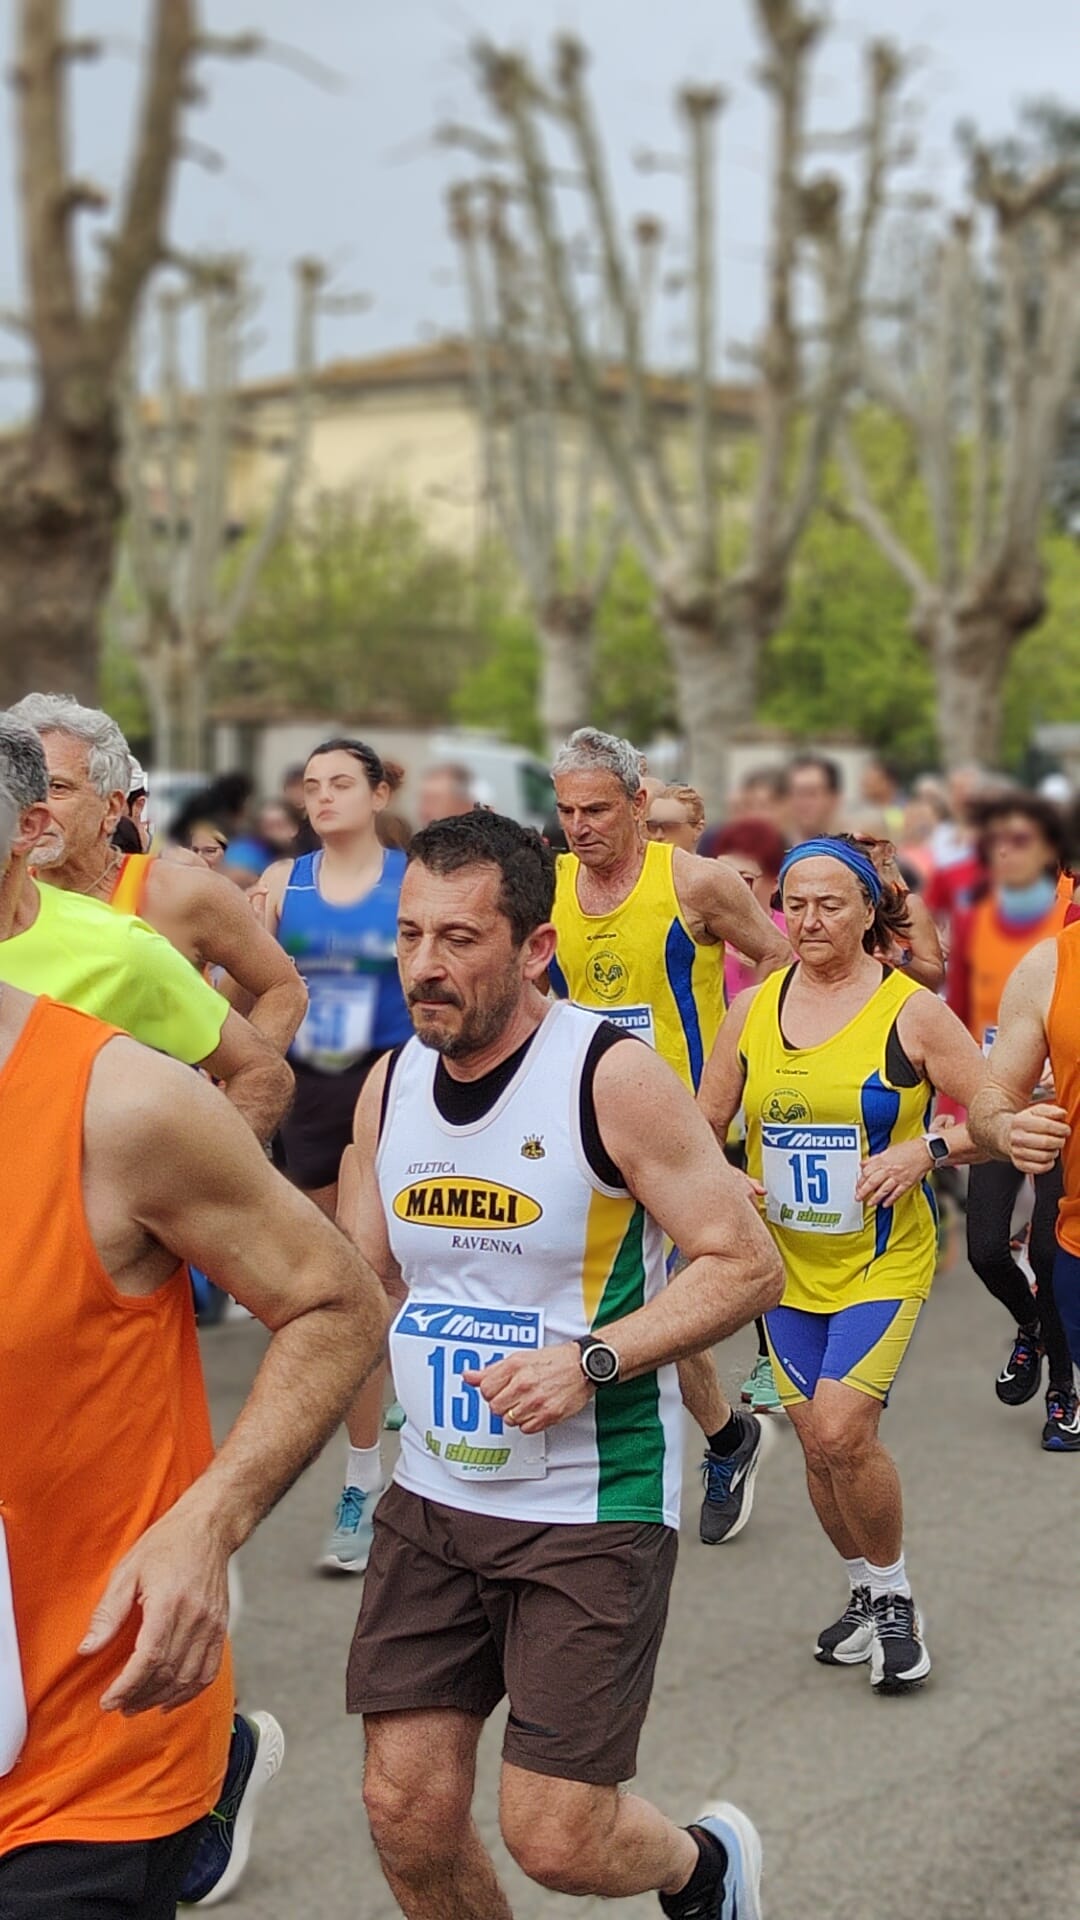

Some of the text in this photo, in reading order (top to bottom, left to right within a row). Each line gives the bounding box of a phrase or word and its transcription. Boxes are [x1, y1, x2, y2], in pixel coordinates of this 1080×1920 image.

[405, 1161, 456, 1175] ATLETICA
[788, 1153, 829, 1205] 15
[405, 1187, 519, 1224] MAMELI
[451, 1234, 523, 1255] RAVENNA
